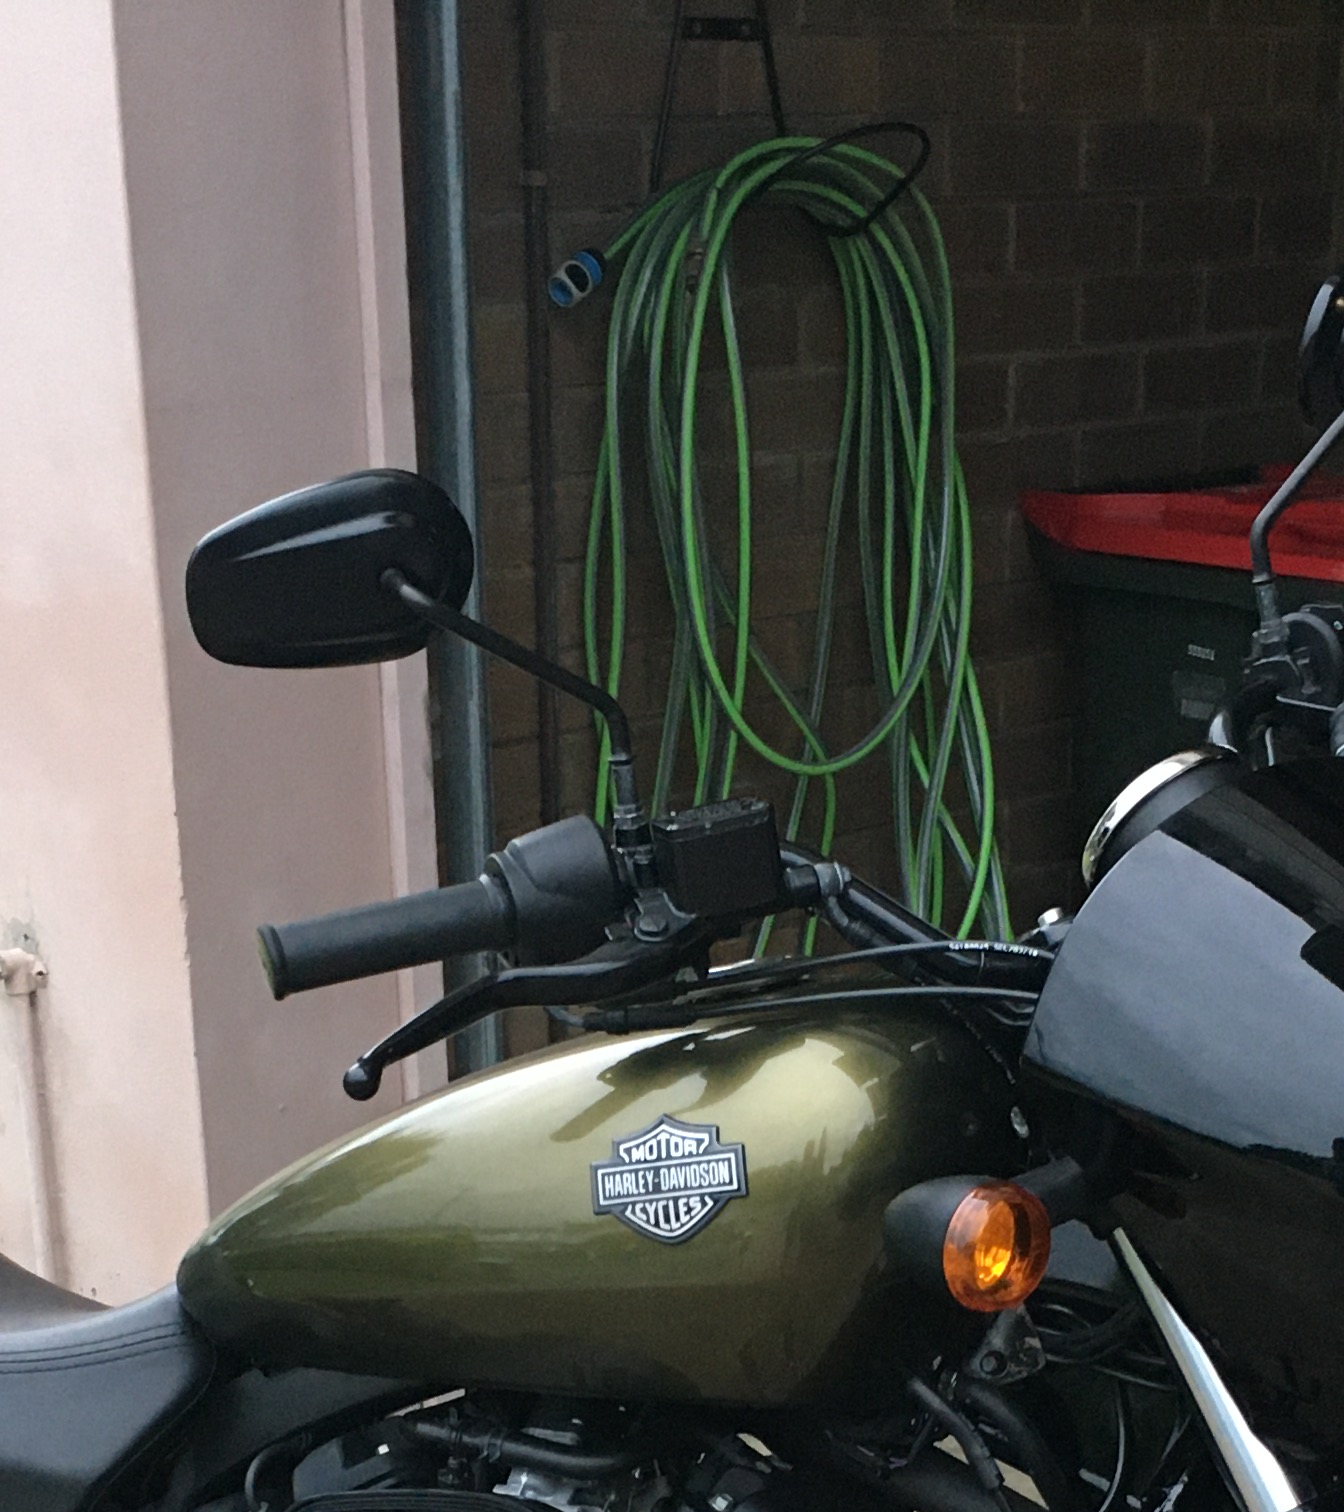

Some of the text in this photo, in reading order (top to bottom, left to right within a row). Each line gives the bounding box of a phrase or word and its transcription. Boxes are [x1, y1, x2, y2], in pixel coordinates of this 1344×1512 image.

[630, 1131, 698, 1163] MOTOR
[604, 1160, 731, 1198] HARLEY-DAVIDSON
[634, 1195, 703, 1231] CYCLES
